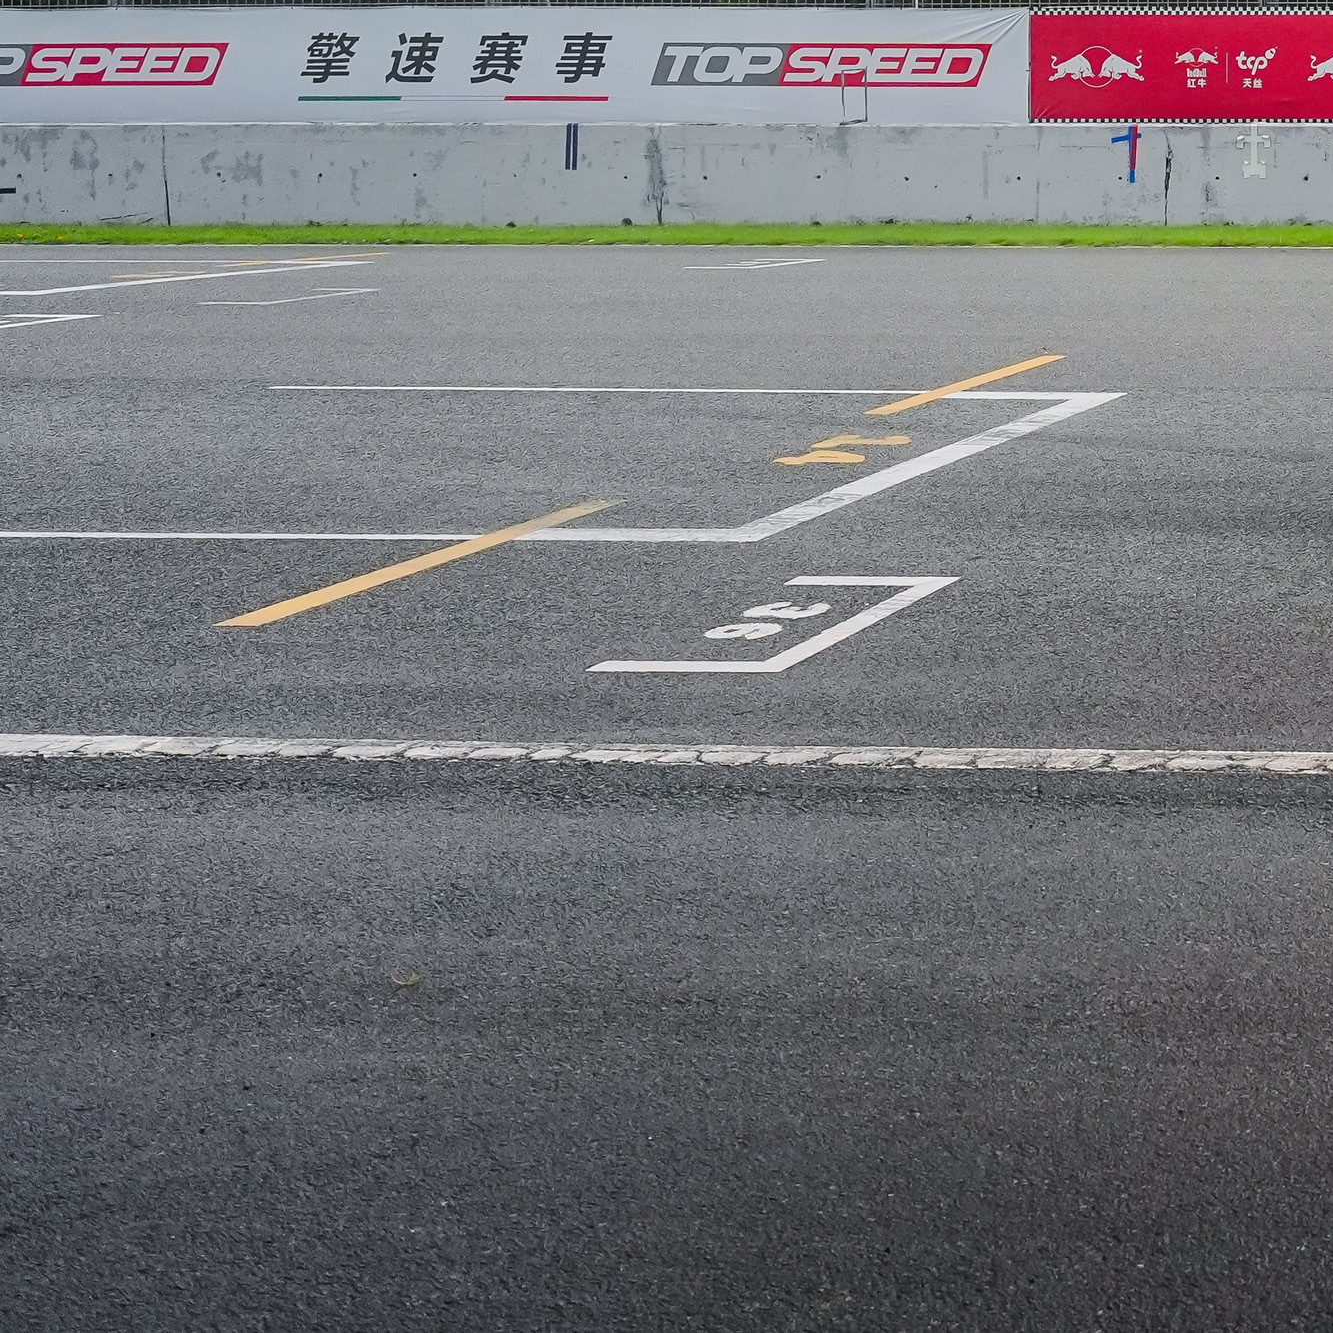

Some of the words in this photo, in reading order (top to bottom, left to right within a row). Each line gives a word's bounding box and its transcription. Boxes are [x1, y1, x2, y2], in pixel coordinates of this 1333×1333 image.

[26, 47, 221, 83] SPEED
[301, 32, 612, 85] 擎速赛事
[662, 45, 783, 83] TOP
[784, 45, 986, 83] SPEED
[1236, 51, 1268, 76] tcp
[1186, 78, 1206, 88] 红牛
[1242, 78, 1262, 88] 天丝
